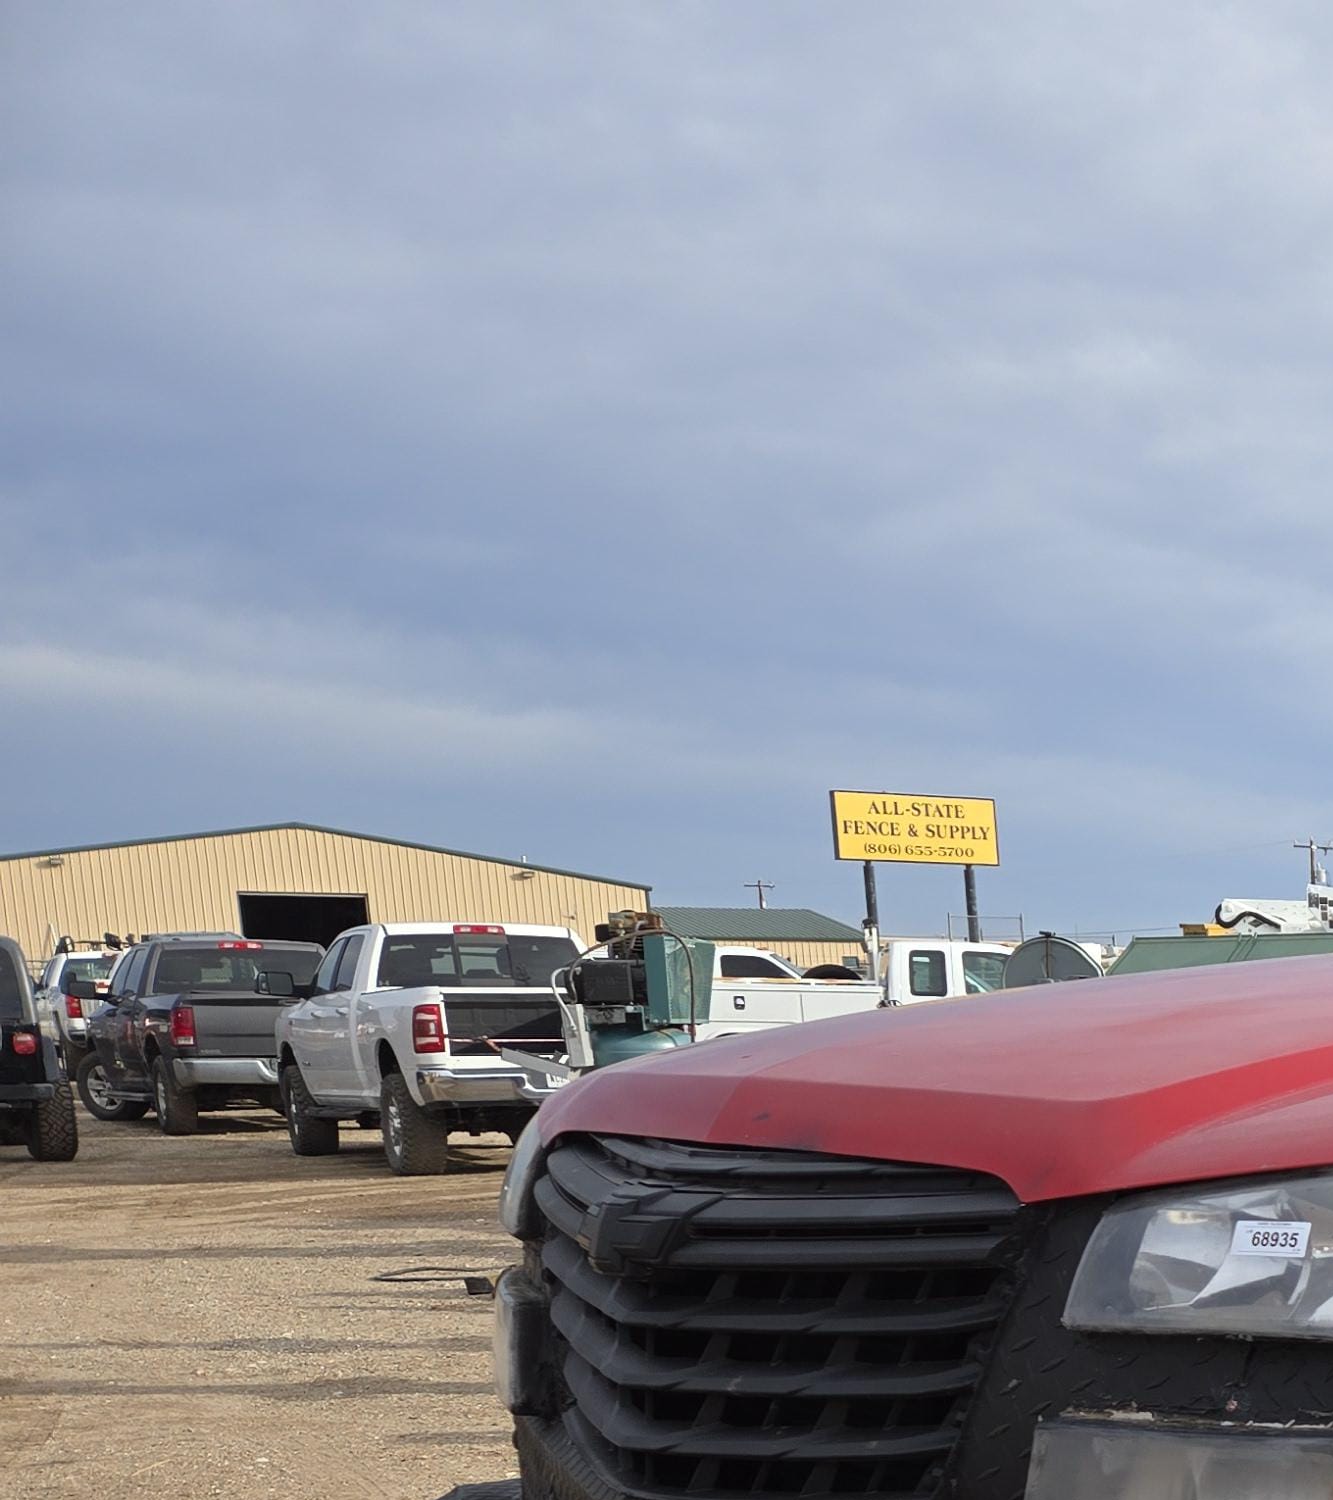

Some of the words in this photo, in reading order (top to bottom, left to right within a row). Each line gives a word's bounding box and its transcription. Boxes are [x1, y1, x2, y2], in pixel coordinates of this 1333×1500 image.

[868, 801, 965, 818] ALL-STATE
[843, 820, 901, 837] FENCE
[908, 824, 919, 838] &
[925, 824, 990, 840] SUPPLY
[864, 842, 901, 856] (806)
[905, 845, 975, 858] 655-5700
[1252, 1231, 1299, 1247] 68935
